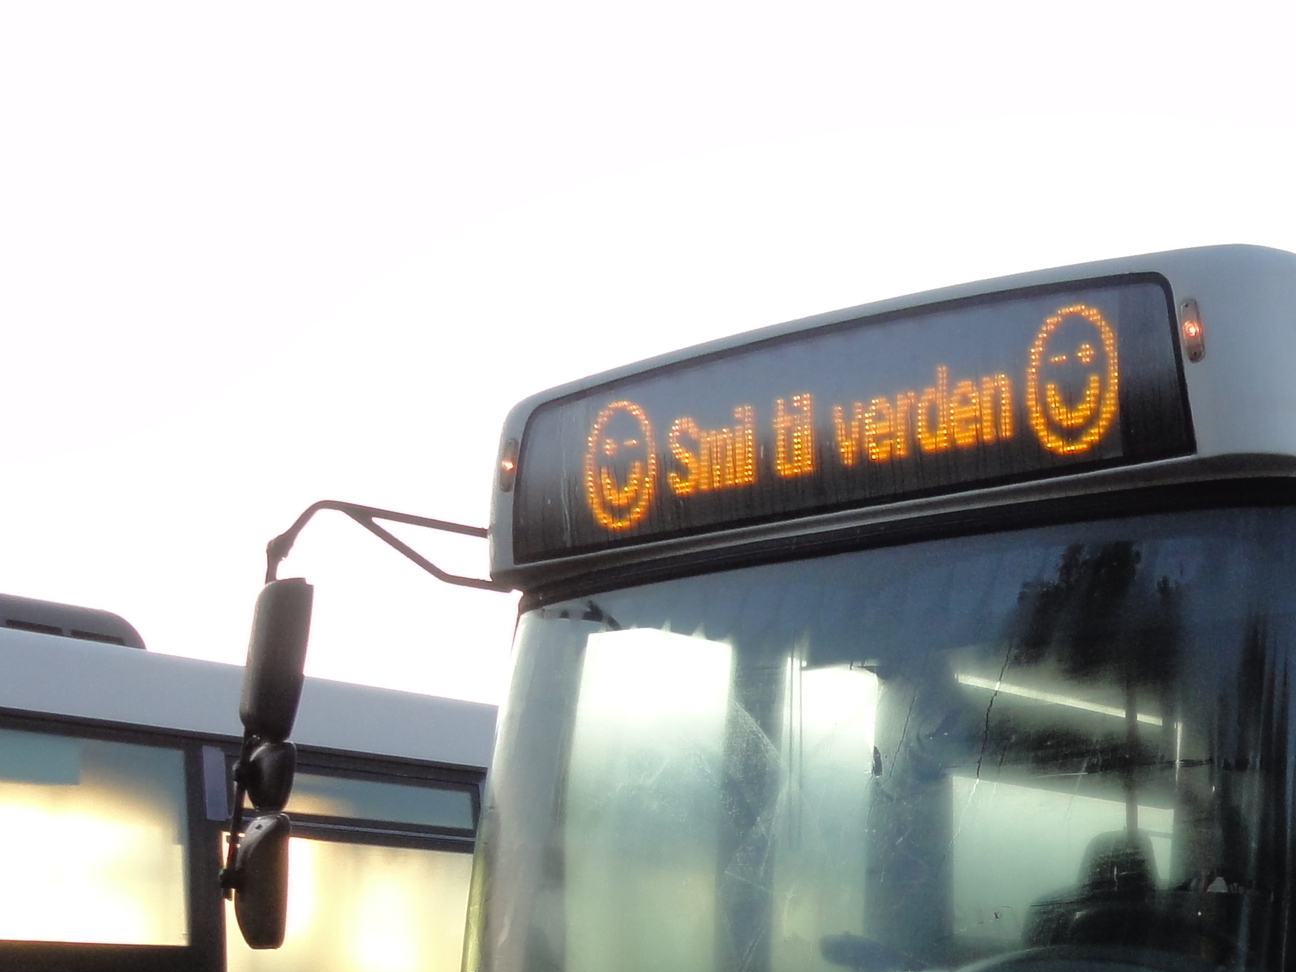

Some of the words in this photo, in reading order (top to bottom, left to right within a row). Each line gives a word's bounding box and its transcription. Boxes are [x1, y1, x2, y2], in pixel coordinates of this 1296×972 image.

[668, 405, 755, 495] Smil
[774, 394, 815, 477] til
[832, 366, 1014, 466] verden
